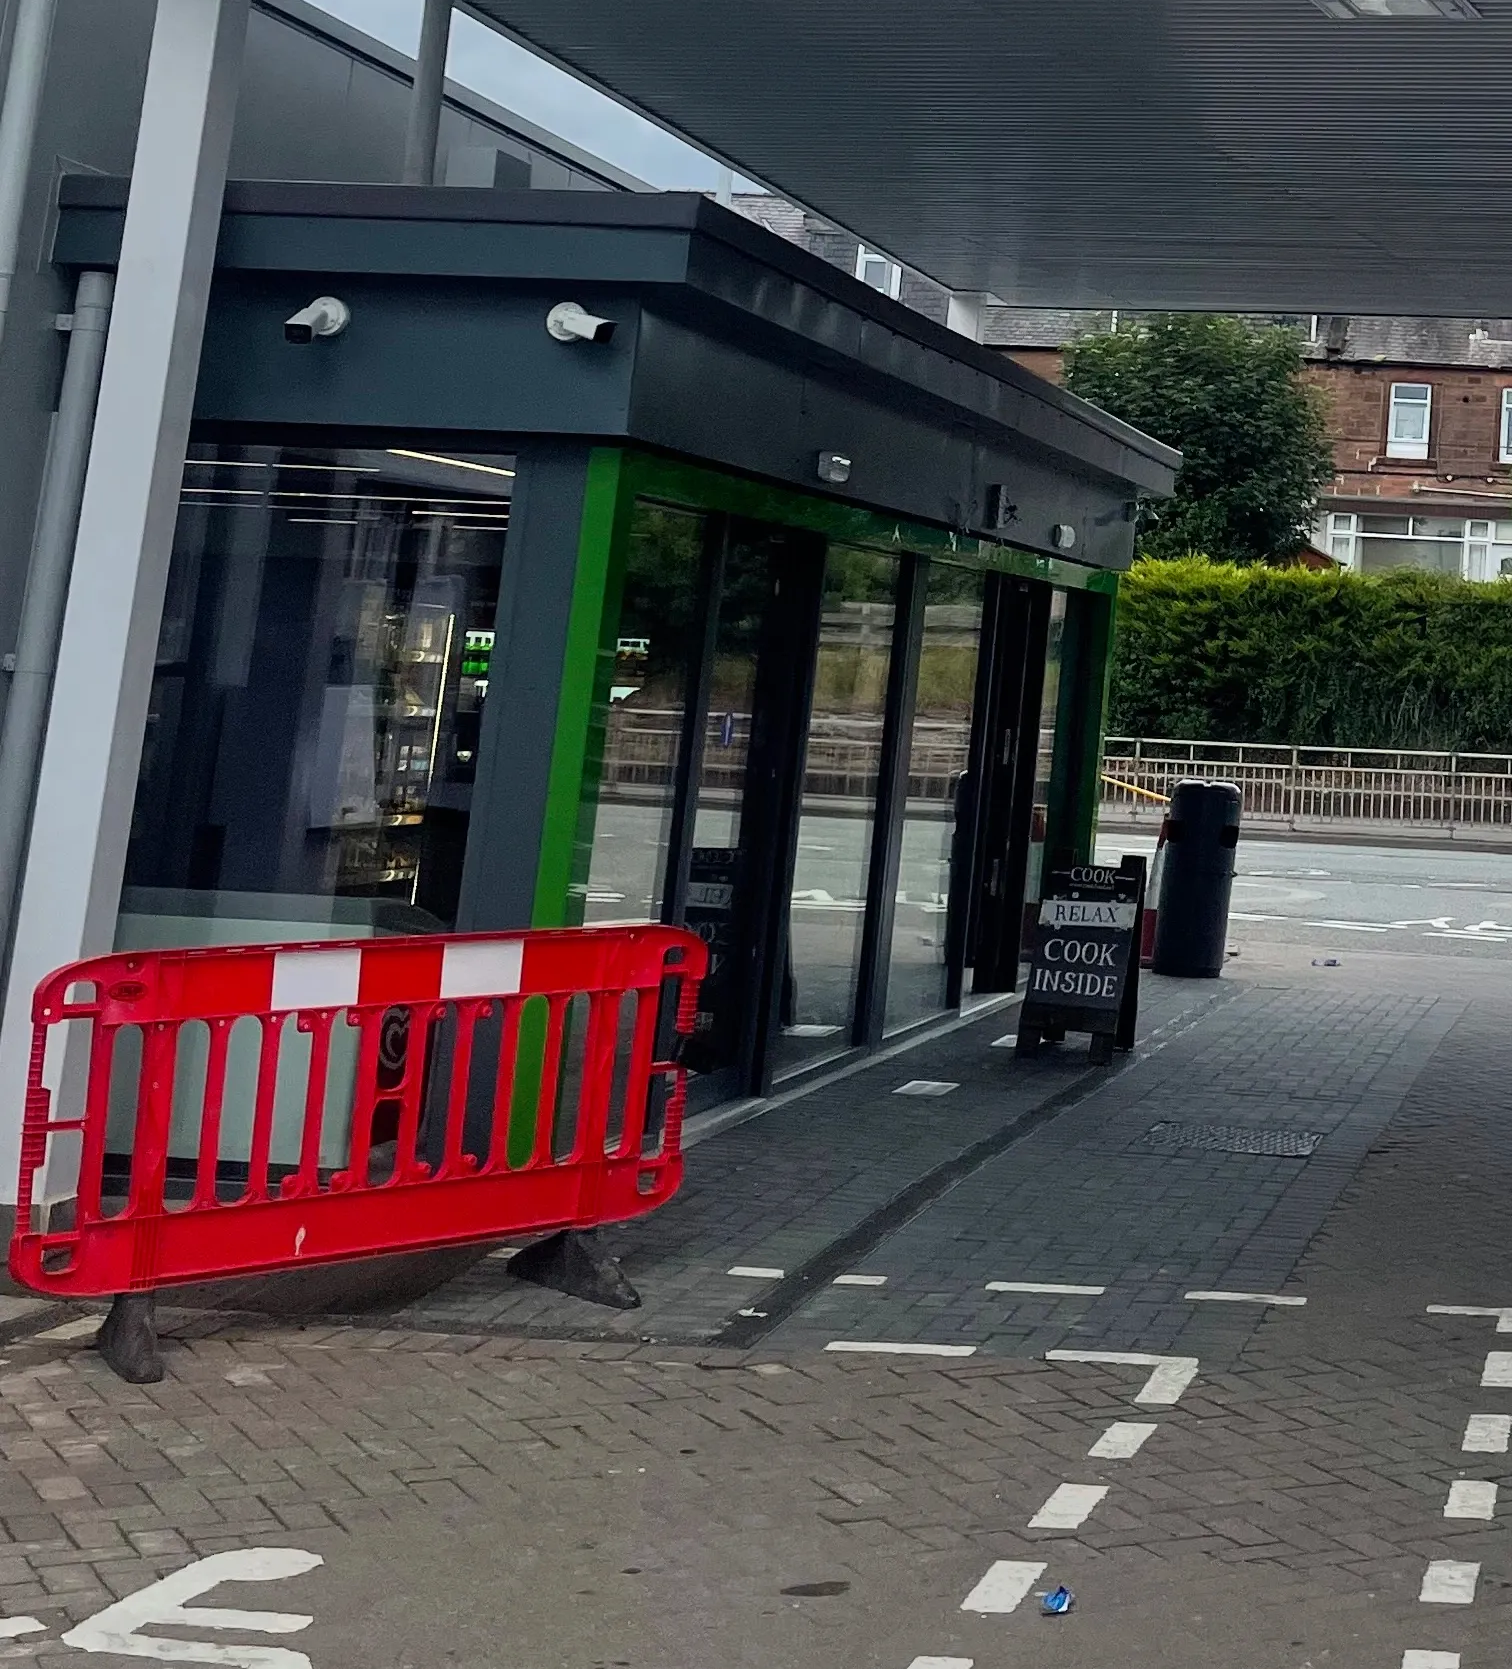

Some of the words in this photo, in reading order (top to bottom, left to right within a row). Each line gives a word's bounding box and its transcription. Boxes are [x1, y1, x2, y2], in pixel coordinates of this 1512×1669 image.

[1070, 867, 1116, 883] COOK
[1055, 905, 1119, 923] RELAX
[1044, 938, 1119, 966] COOK
[1033, 968, 1118, 997] INSIDE
